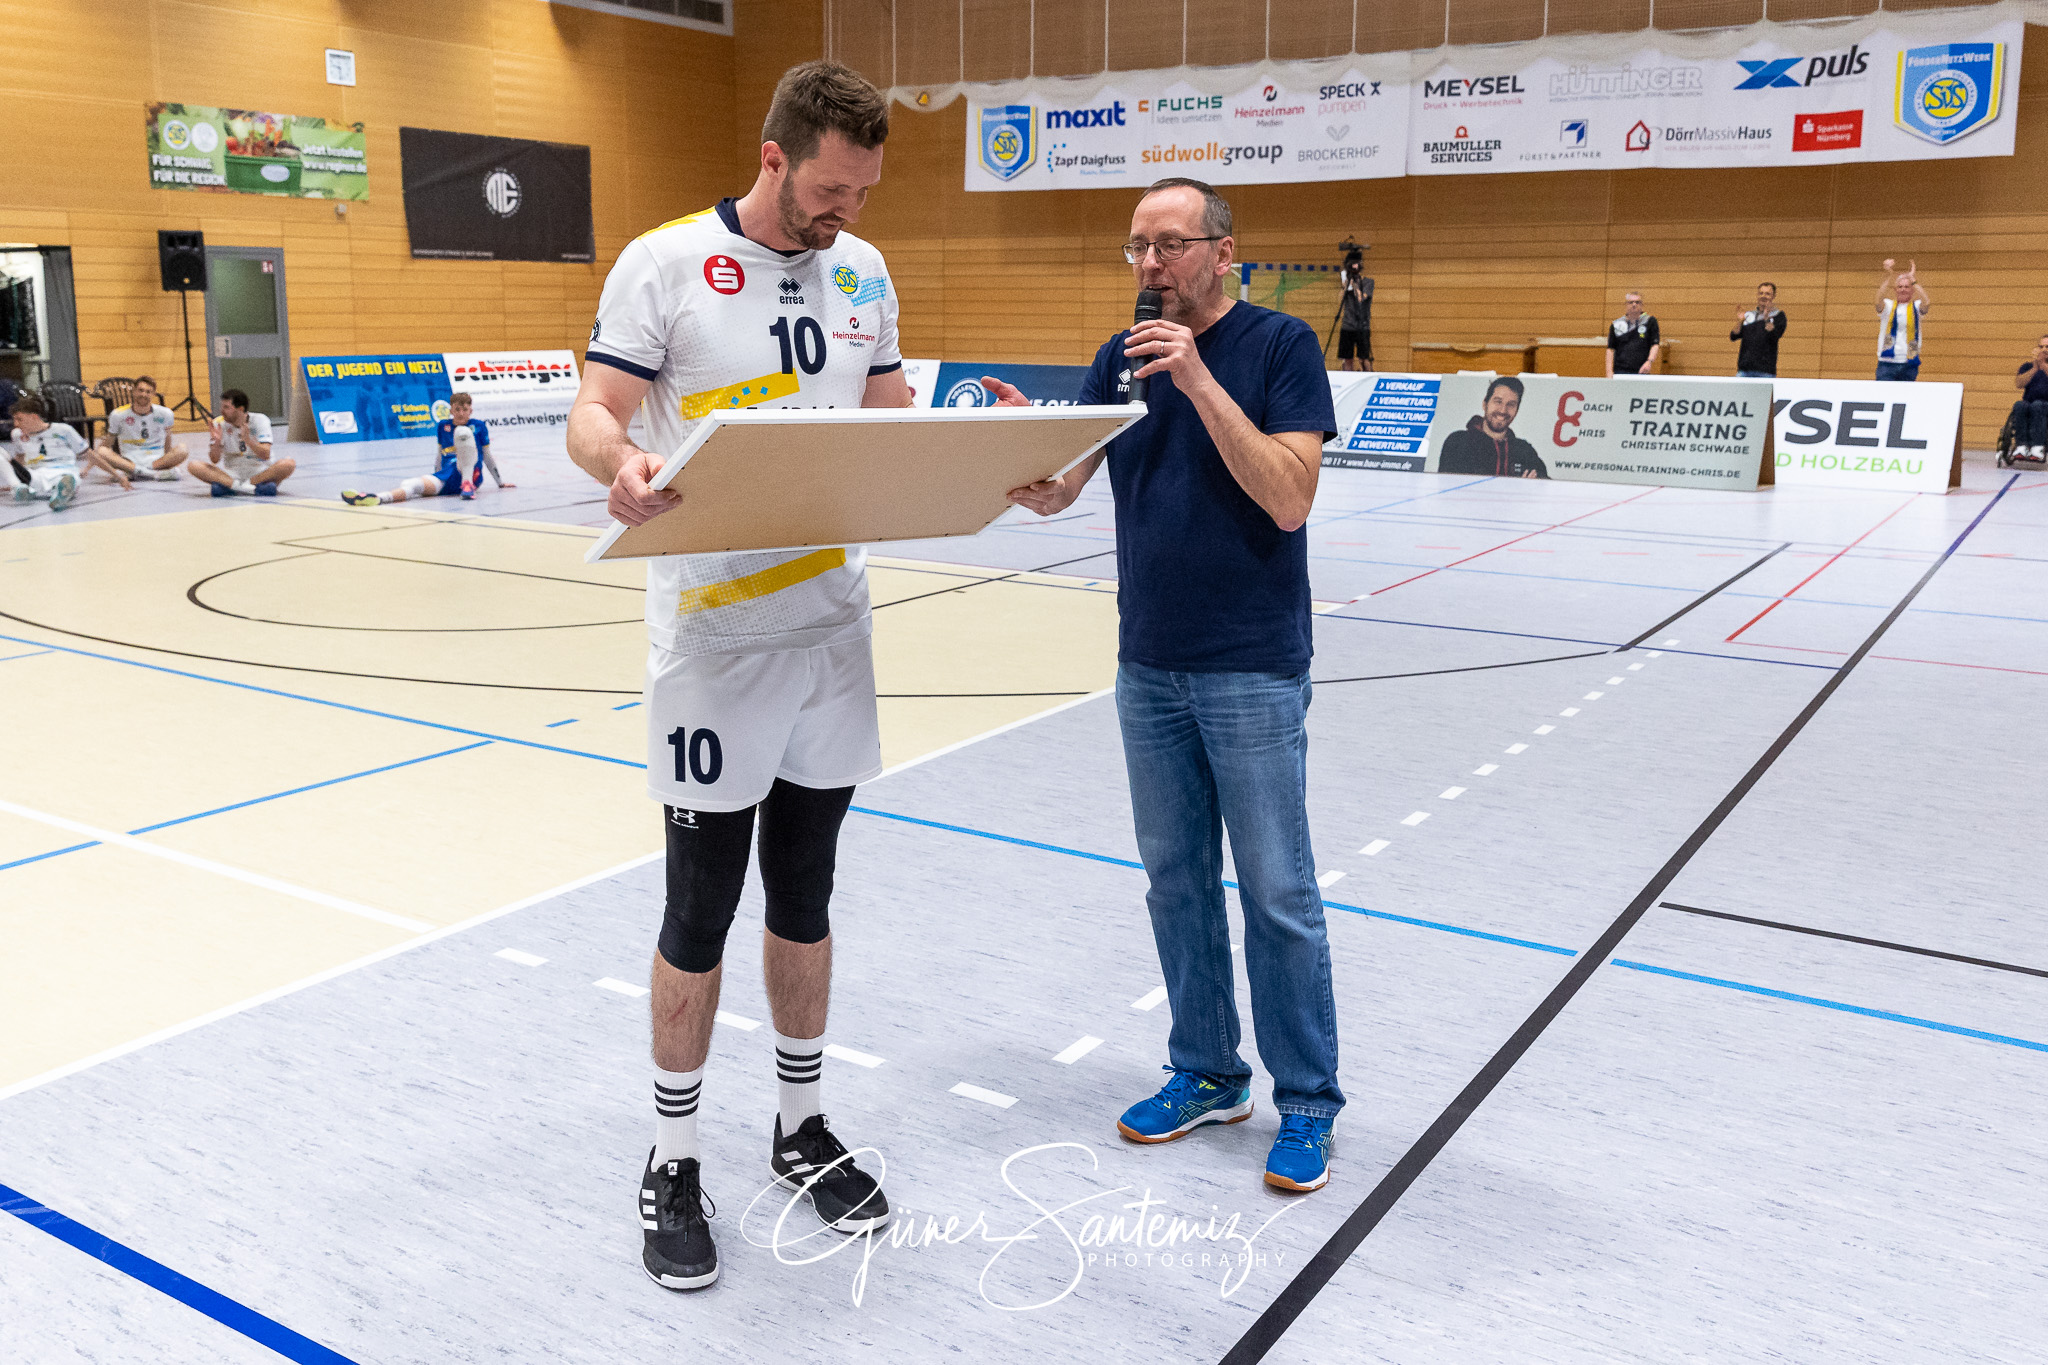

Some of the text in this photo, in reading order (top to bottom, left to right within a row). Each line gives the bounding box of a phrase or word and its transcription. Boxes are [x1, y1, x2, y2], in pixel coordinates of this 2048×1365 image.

[1804, 44, 1870, 87] puls
[1319, 82, 1365, 100] SPECK
[1424, 75, 1525, 98] MEYSEL
[1157, 95, 1223, 112] FUCHS
[1318, 99, 1366, 116] pumpen
[1423, 101, 1448, 111] Druck
[1460, 97, 1524, 109] Werbetechnik
[1046, 100, 1126, 129] maxit
[1182, 113, 1222, 124] umsetzen
[1234, 105, 1305, 118] Heinzelmann
[1256, 120, 1283, 128] Medien
[1817, 122, 1854, 134] Sparkasse
[1665, 126, 1772, 141] DörrMassivHaus
[1816, 132, 1852, 143] Nürnberg
[1298, 145, 1380, 162] BROCKERHOF
[1430, 151, 1493, 164] SERVICES
[1055, 155, 1127, 167] Zapf Daigfuss
[779, 295, 805, 305] errea
[832, 331, 876, 342] Heinzelmann
[769, 316, 827, 376] 10
[849, 340, 866, 348] Medien
[307, 360, 444, 380] DER JUGEND EIN NETZ!
[454, 360, 571, 384] schweiger
[1385, 381, 1426, 391] VERKAUF
[1379, 396, 1434, 408] VERMIETUNG
[1629, 397, 1754, 418] PERSONAL
[1372, 410, 1429, 422] VERWALTUNG
[141, 427, 149, 440] 6
[1364, 425, 1411, 436] BERATUNG
[1629, 420, 1748, 441] TRAINING
[1357, 440, 1412, 452] BEWERTUNG
[1621, 440, 1751, 455] CHRISTIAN SCHWABE
[1555, 460, 1741, 479] WWW.PERSONALTRAINING-CHRIS.DE
[1801, 454, 1924, 475] HOLZBAU
[667, 726, 723, 785] 10
